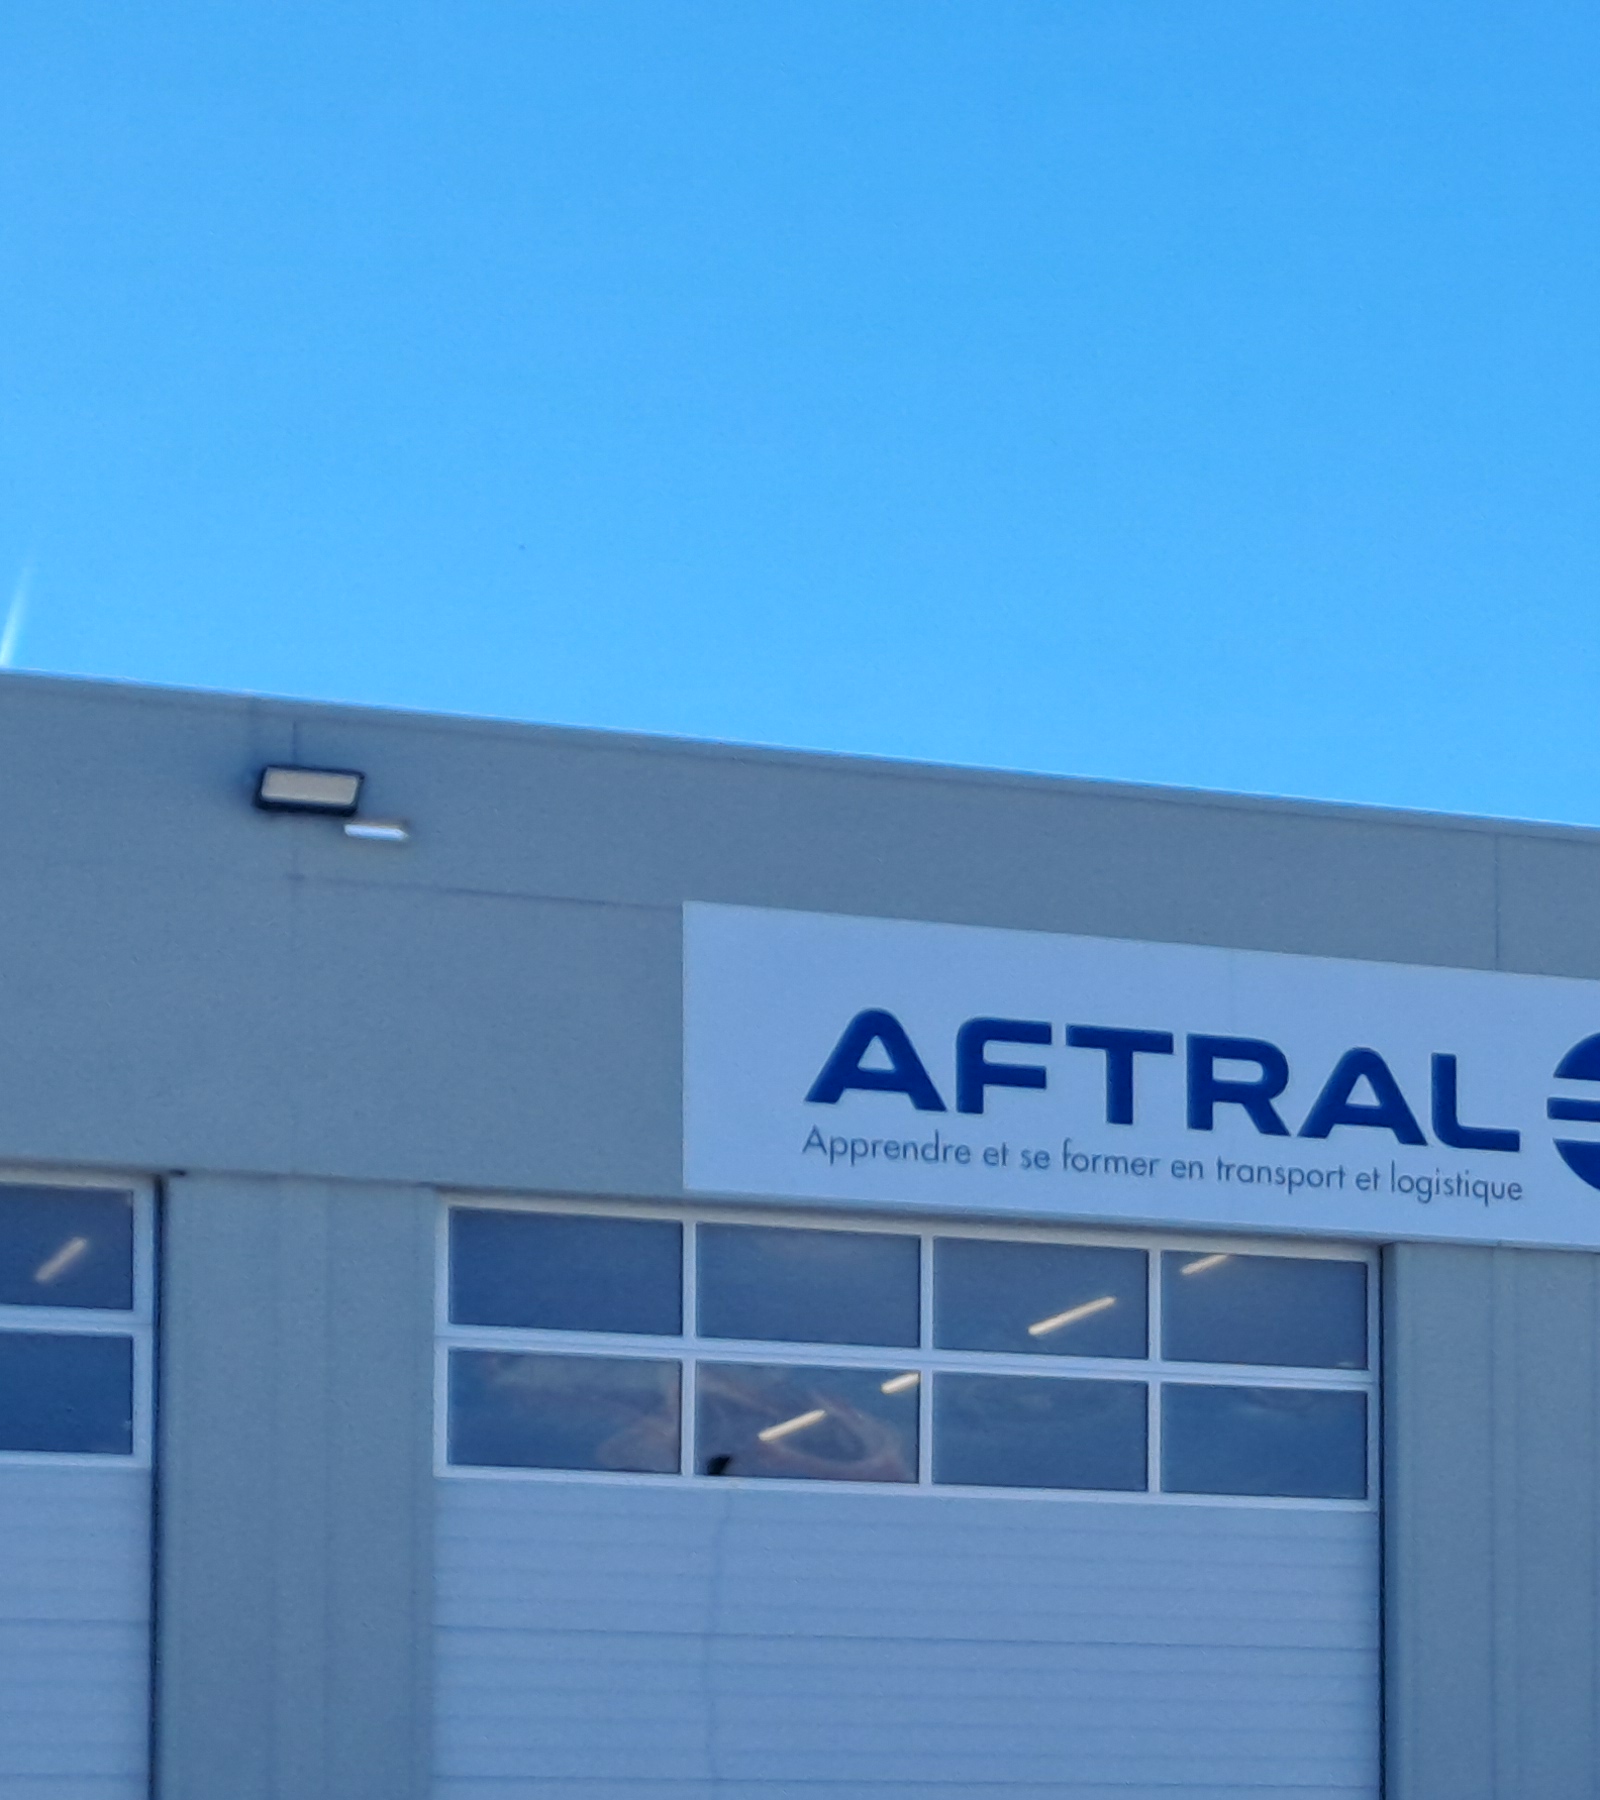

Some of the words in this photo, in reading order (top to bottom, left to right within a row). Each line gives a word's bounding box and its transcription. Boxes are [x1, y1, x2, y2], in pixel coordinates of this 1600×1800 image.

[804, 1008, 1520, 1152] AFTRAL
[802, 1125, 971, 1167] Apprendre
[983, 1143, 1009, 1167] et
[1021, 1146, 1050, 1170] se
[1063, 1138, 1159, 1177] former
[1171, 1158, 1204, 1180] en
[1217, 1155, 1346, 1194] transport
[1356, 1168, 1381, 1192] et
[1390, 1160, 1523, 1206] logistique
